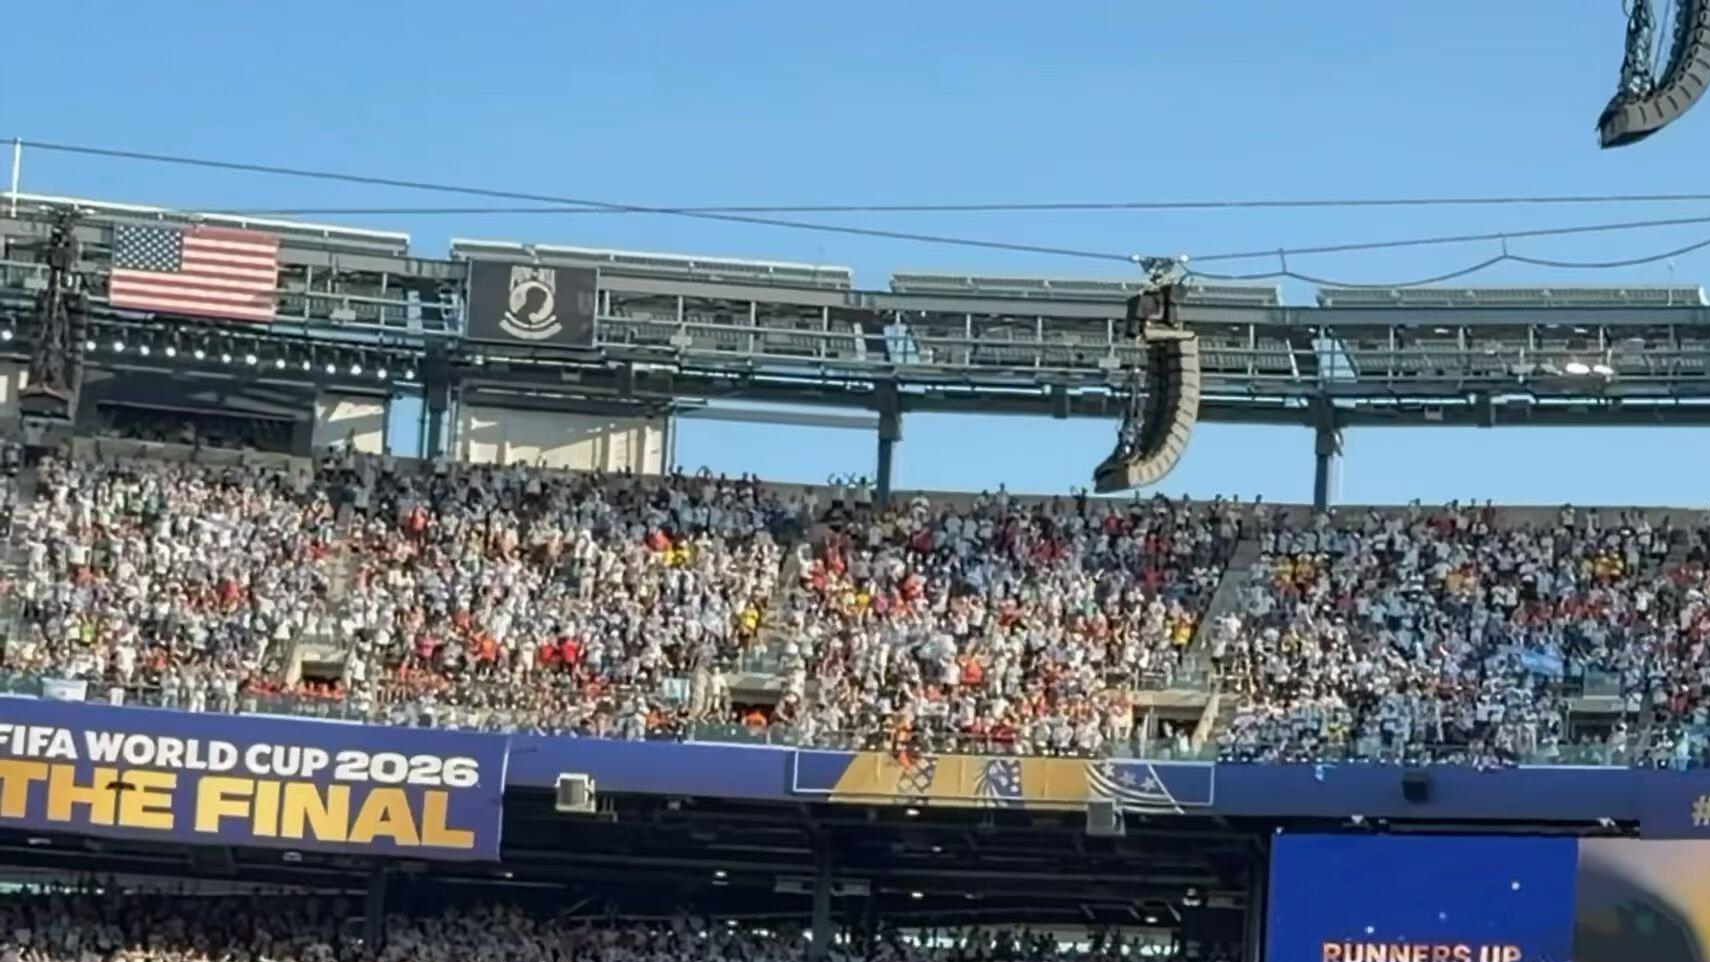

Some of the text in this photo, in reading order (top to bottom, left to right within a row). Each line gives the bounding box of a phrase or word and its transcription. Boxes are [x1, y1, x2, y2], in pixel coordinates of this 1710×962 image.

[84, 730, 238, 772] WORLD
[245, 743, 329, 778] CUP
[334, 750, 480, 788] 2026
[0, 759, 475, 849] THE FINAL
